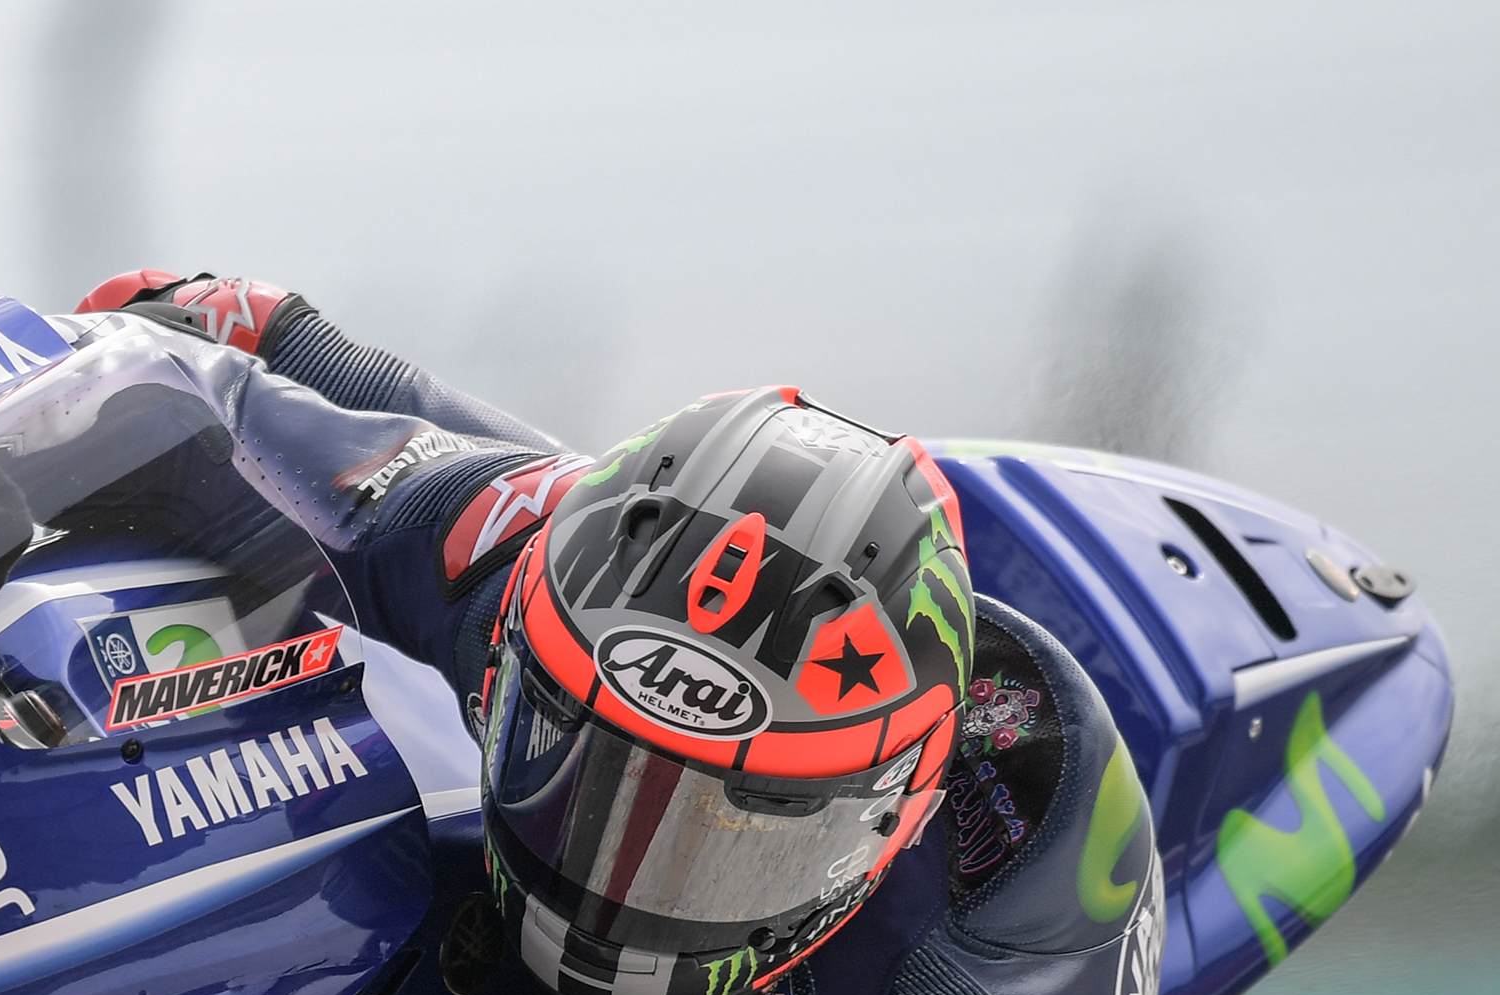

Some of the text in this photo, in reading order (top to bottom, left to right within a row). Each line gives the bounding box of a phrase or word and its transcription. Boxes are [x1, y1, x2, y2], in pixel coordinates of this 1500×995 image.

[113, 639, 313, 725] MAVERICK
[603, 644, 754, 721] Arai
[637, 691, 702, 725] HELMET
[109, 716, 369, 847] YAMAHA
